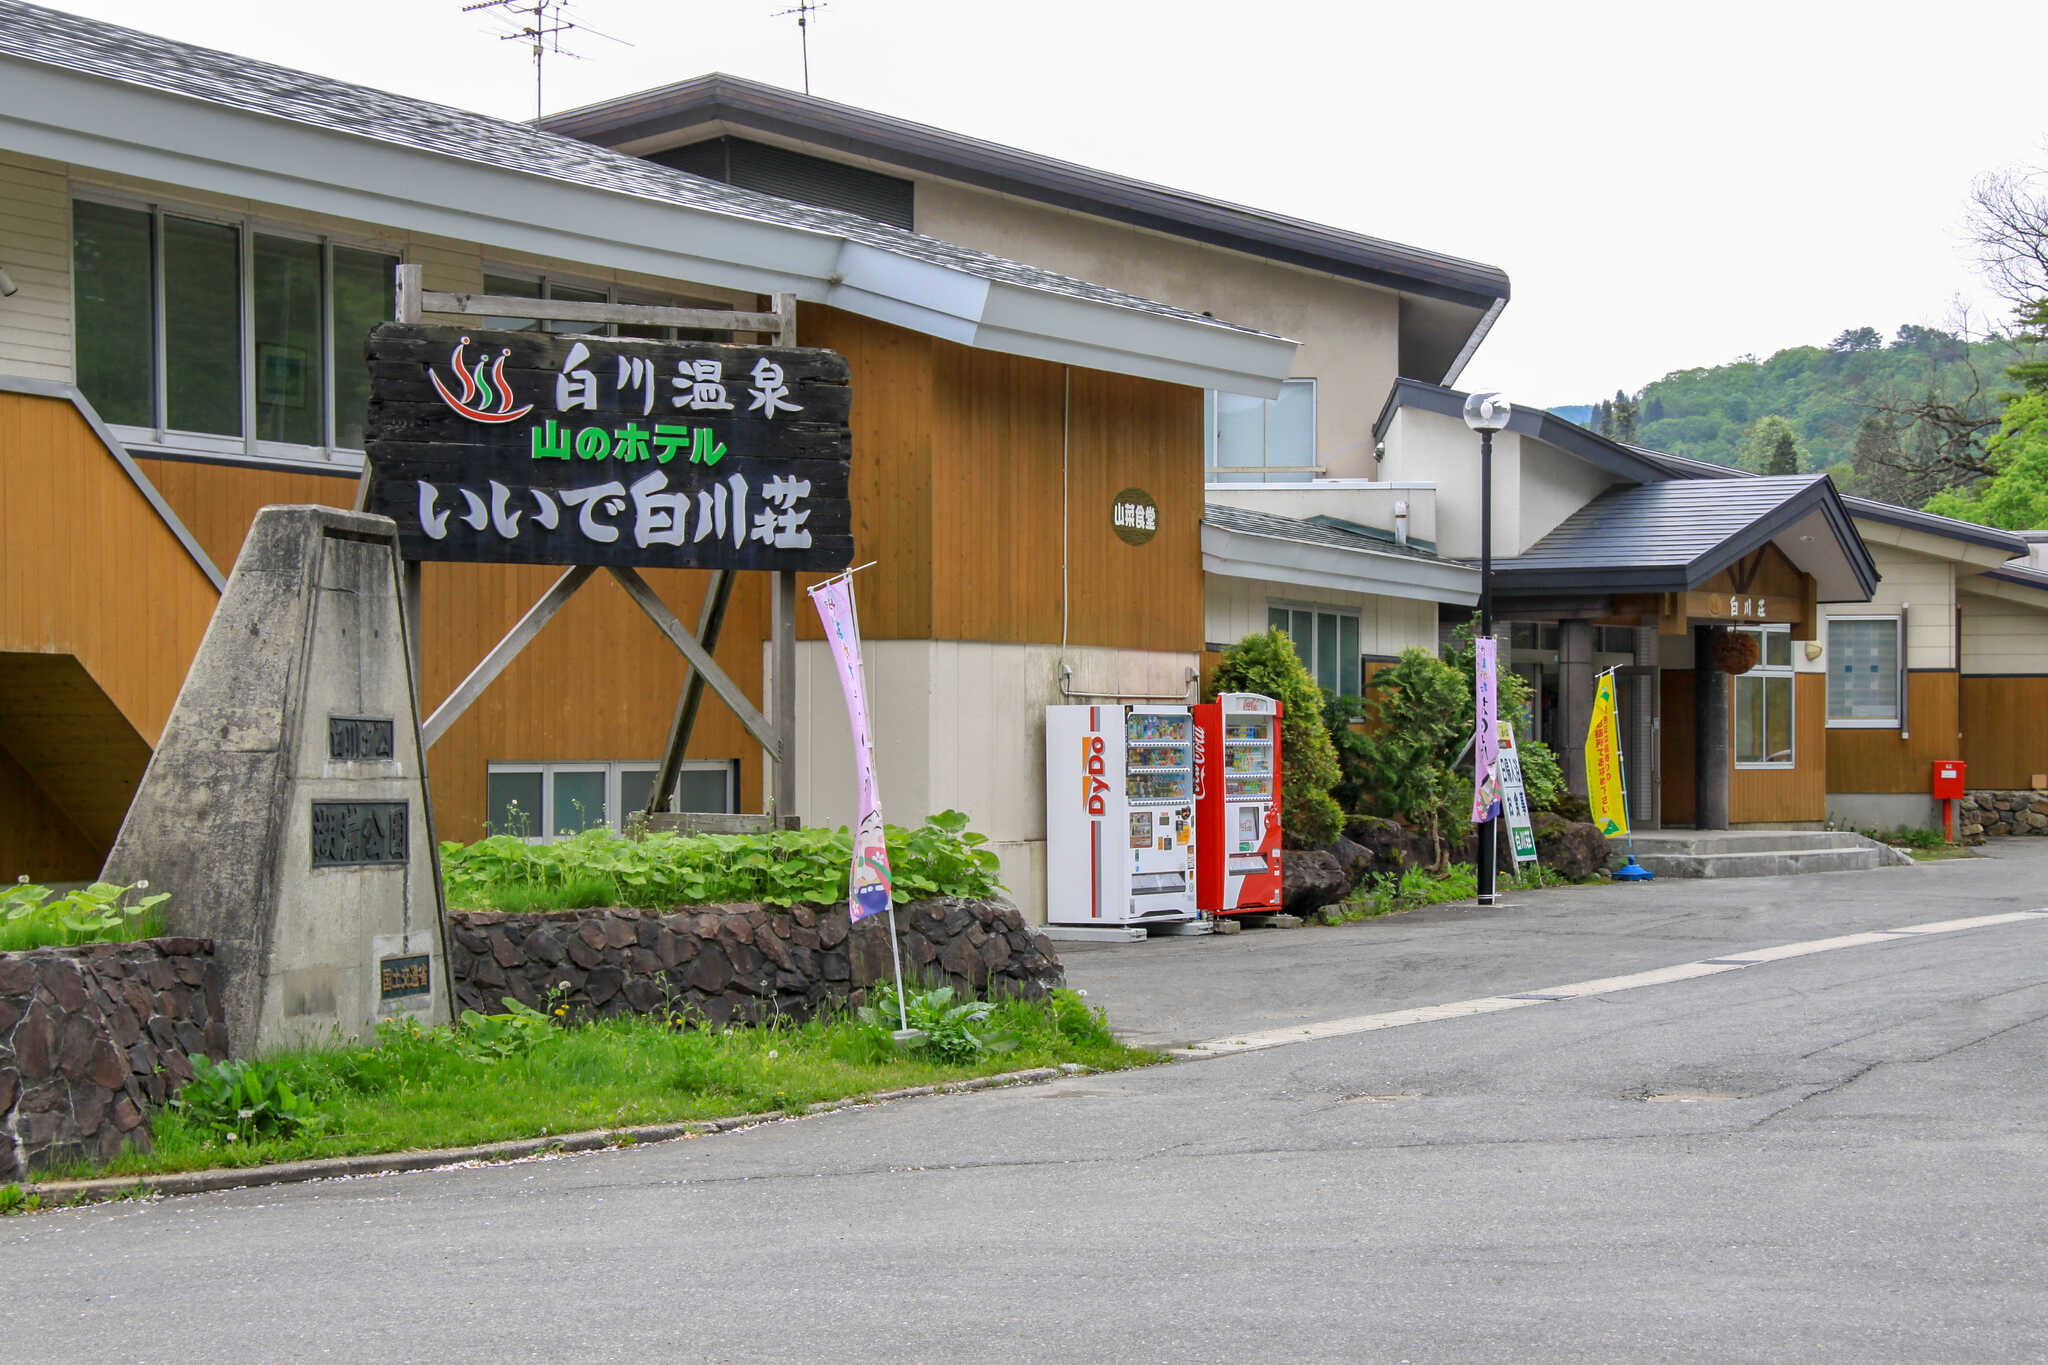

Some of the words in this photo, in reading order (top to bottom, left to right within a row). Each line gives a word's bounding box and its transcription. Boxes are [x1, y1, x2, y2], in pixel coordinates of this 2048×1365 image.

[556, 342, 804, 419] 白川温泉
[532, 420, 727, 466] 山のホテル
[418, 470, 812, 550] いいで白川荘
[1730, 595, 1766, 617] 白川荘
[1088, 736, 1112, 816] DyDo
[1193, 725, 1206, 800] CocaCola
[383, 963, 428, 991] 国土交通省
